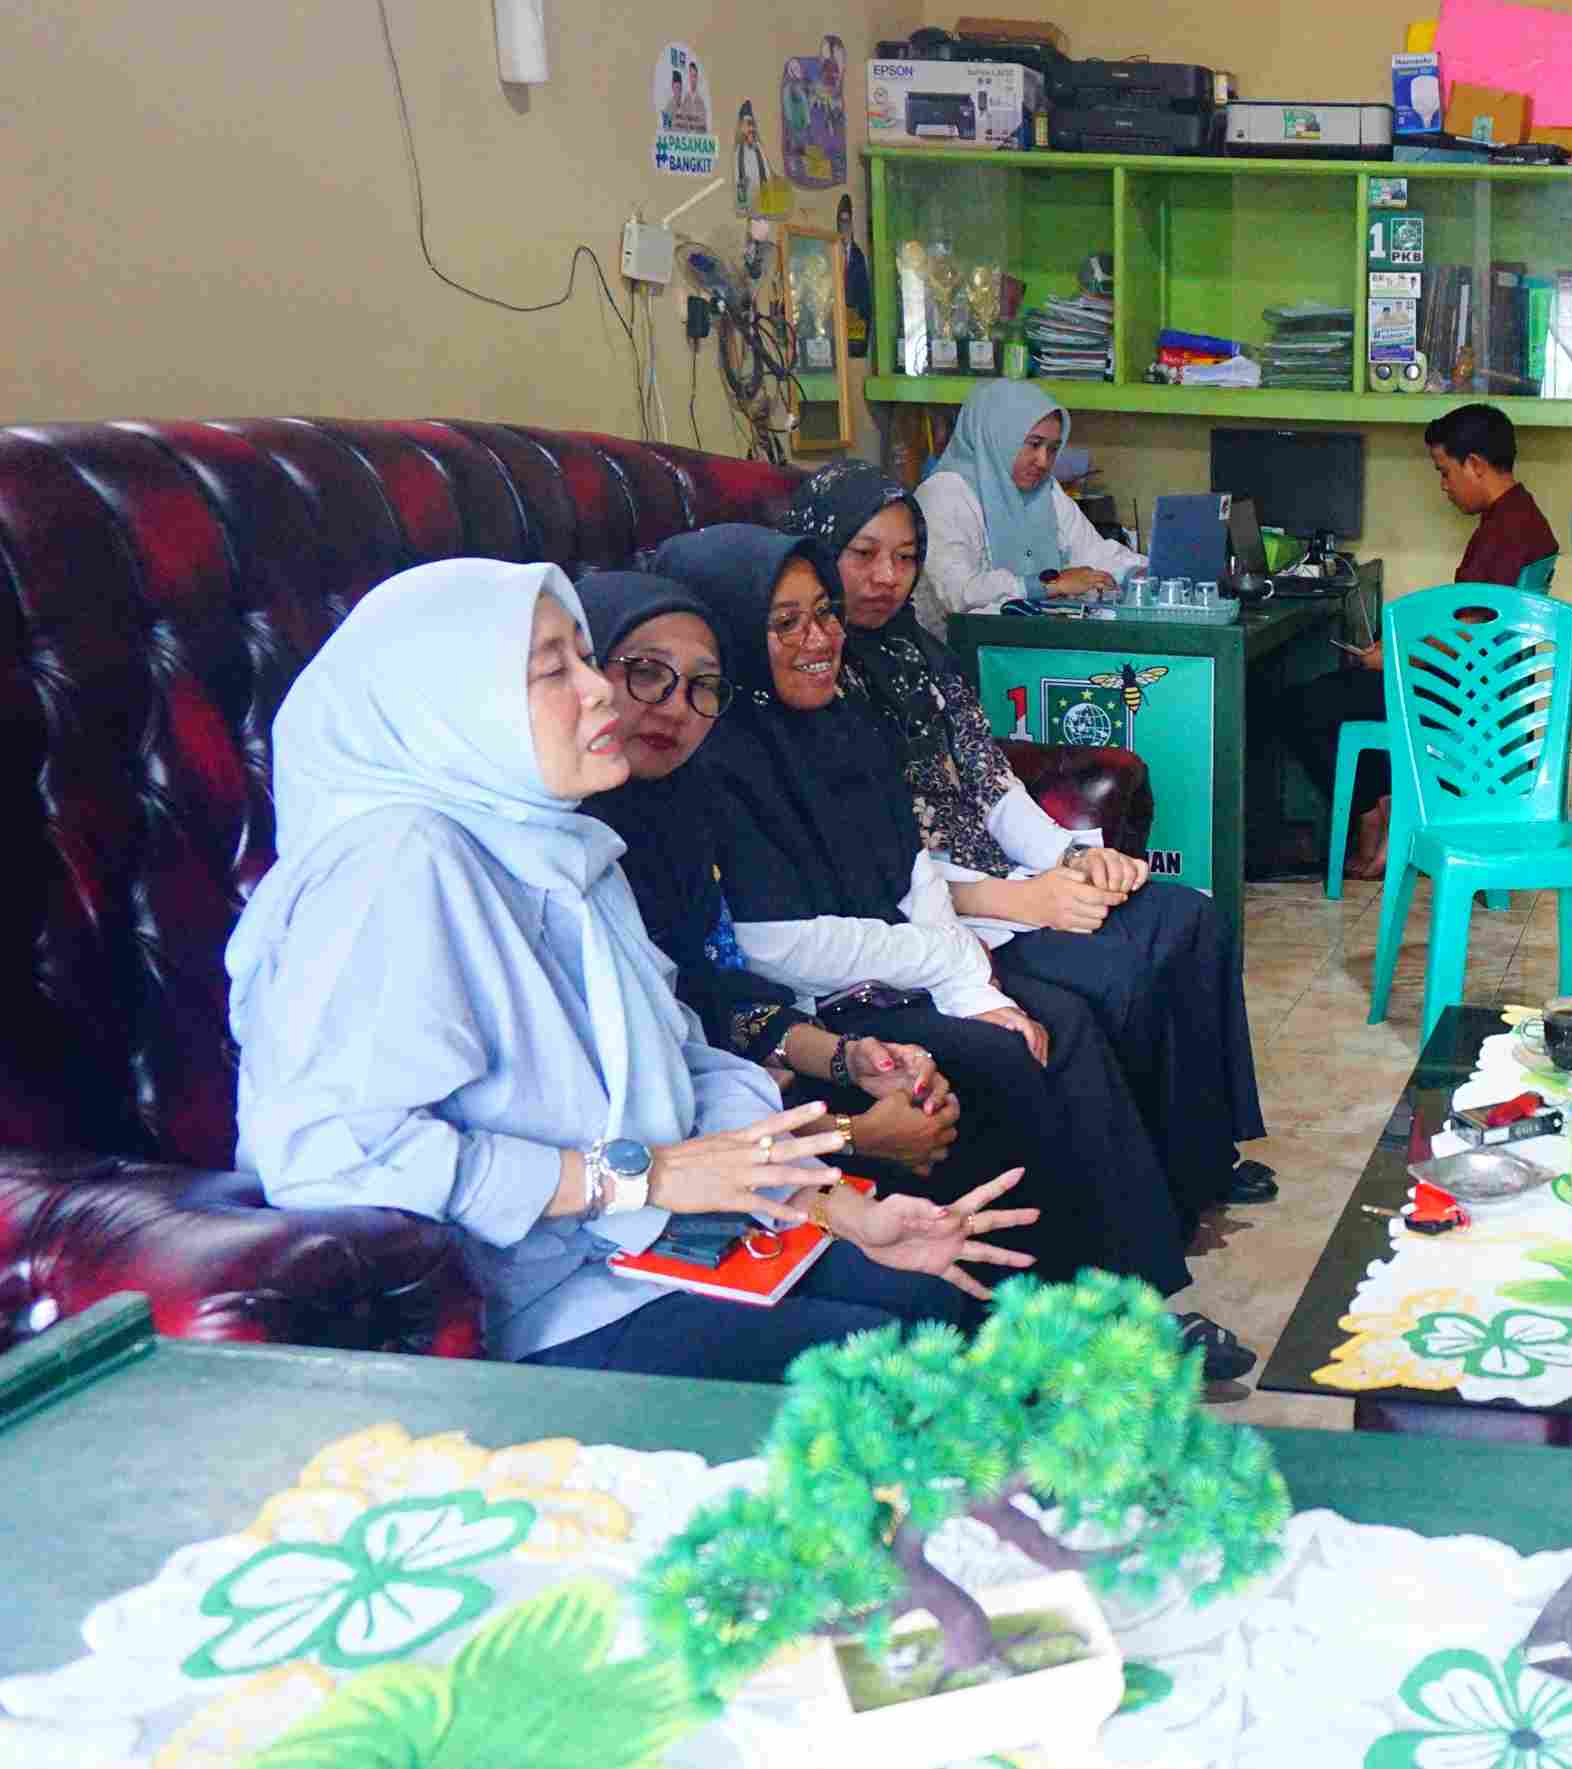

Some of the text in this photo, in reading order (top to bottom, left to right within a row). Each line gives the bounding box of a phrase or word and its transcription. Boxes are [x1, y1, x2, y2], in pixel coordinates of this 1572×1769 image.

[873, 65, 913, 76] EPSON
[1370, 222, 1422, 262] 1 PKB
[1008, 687, 1033, 741] 1
